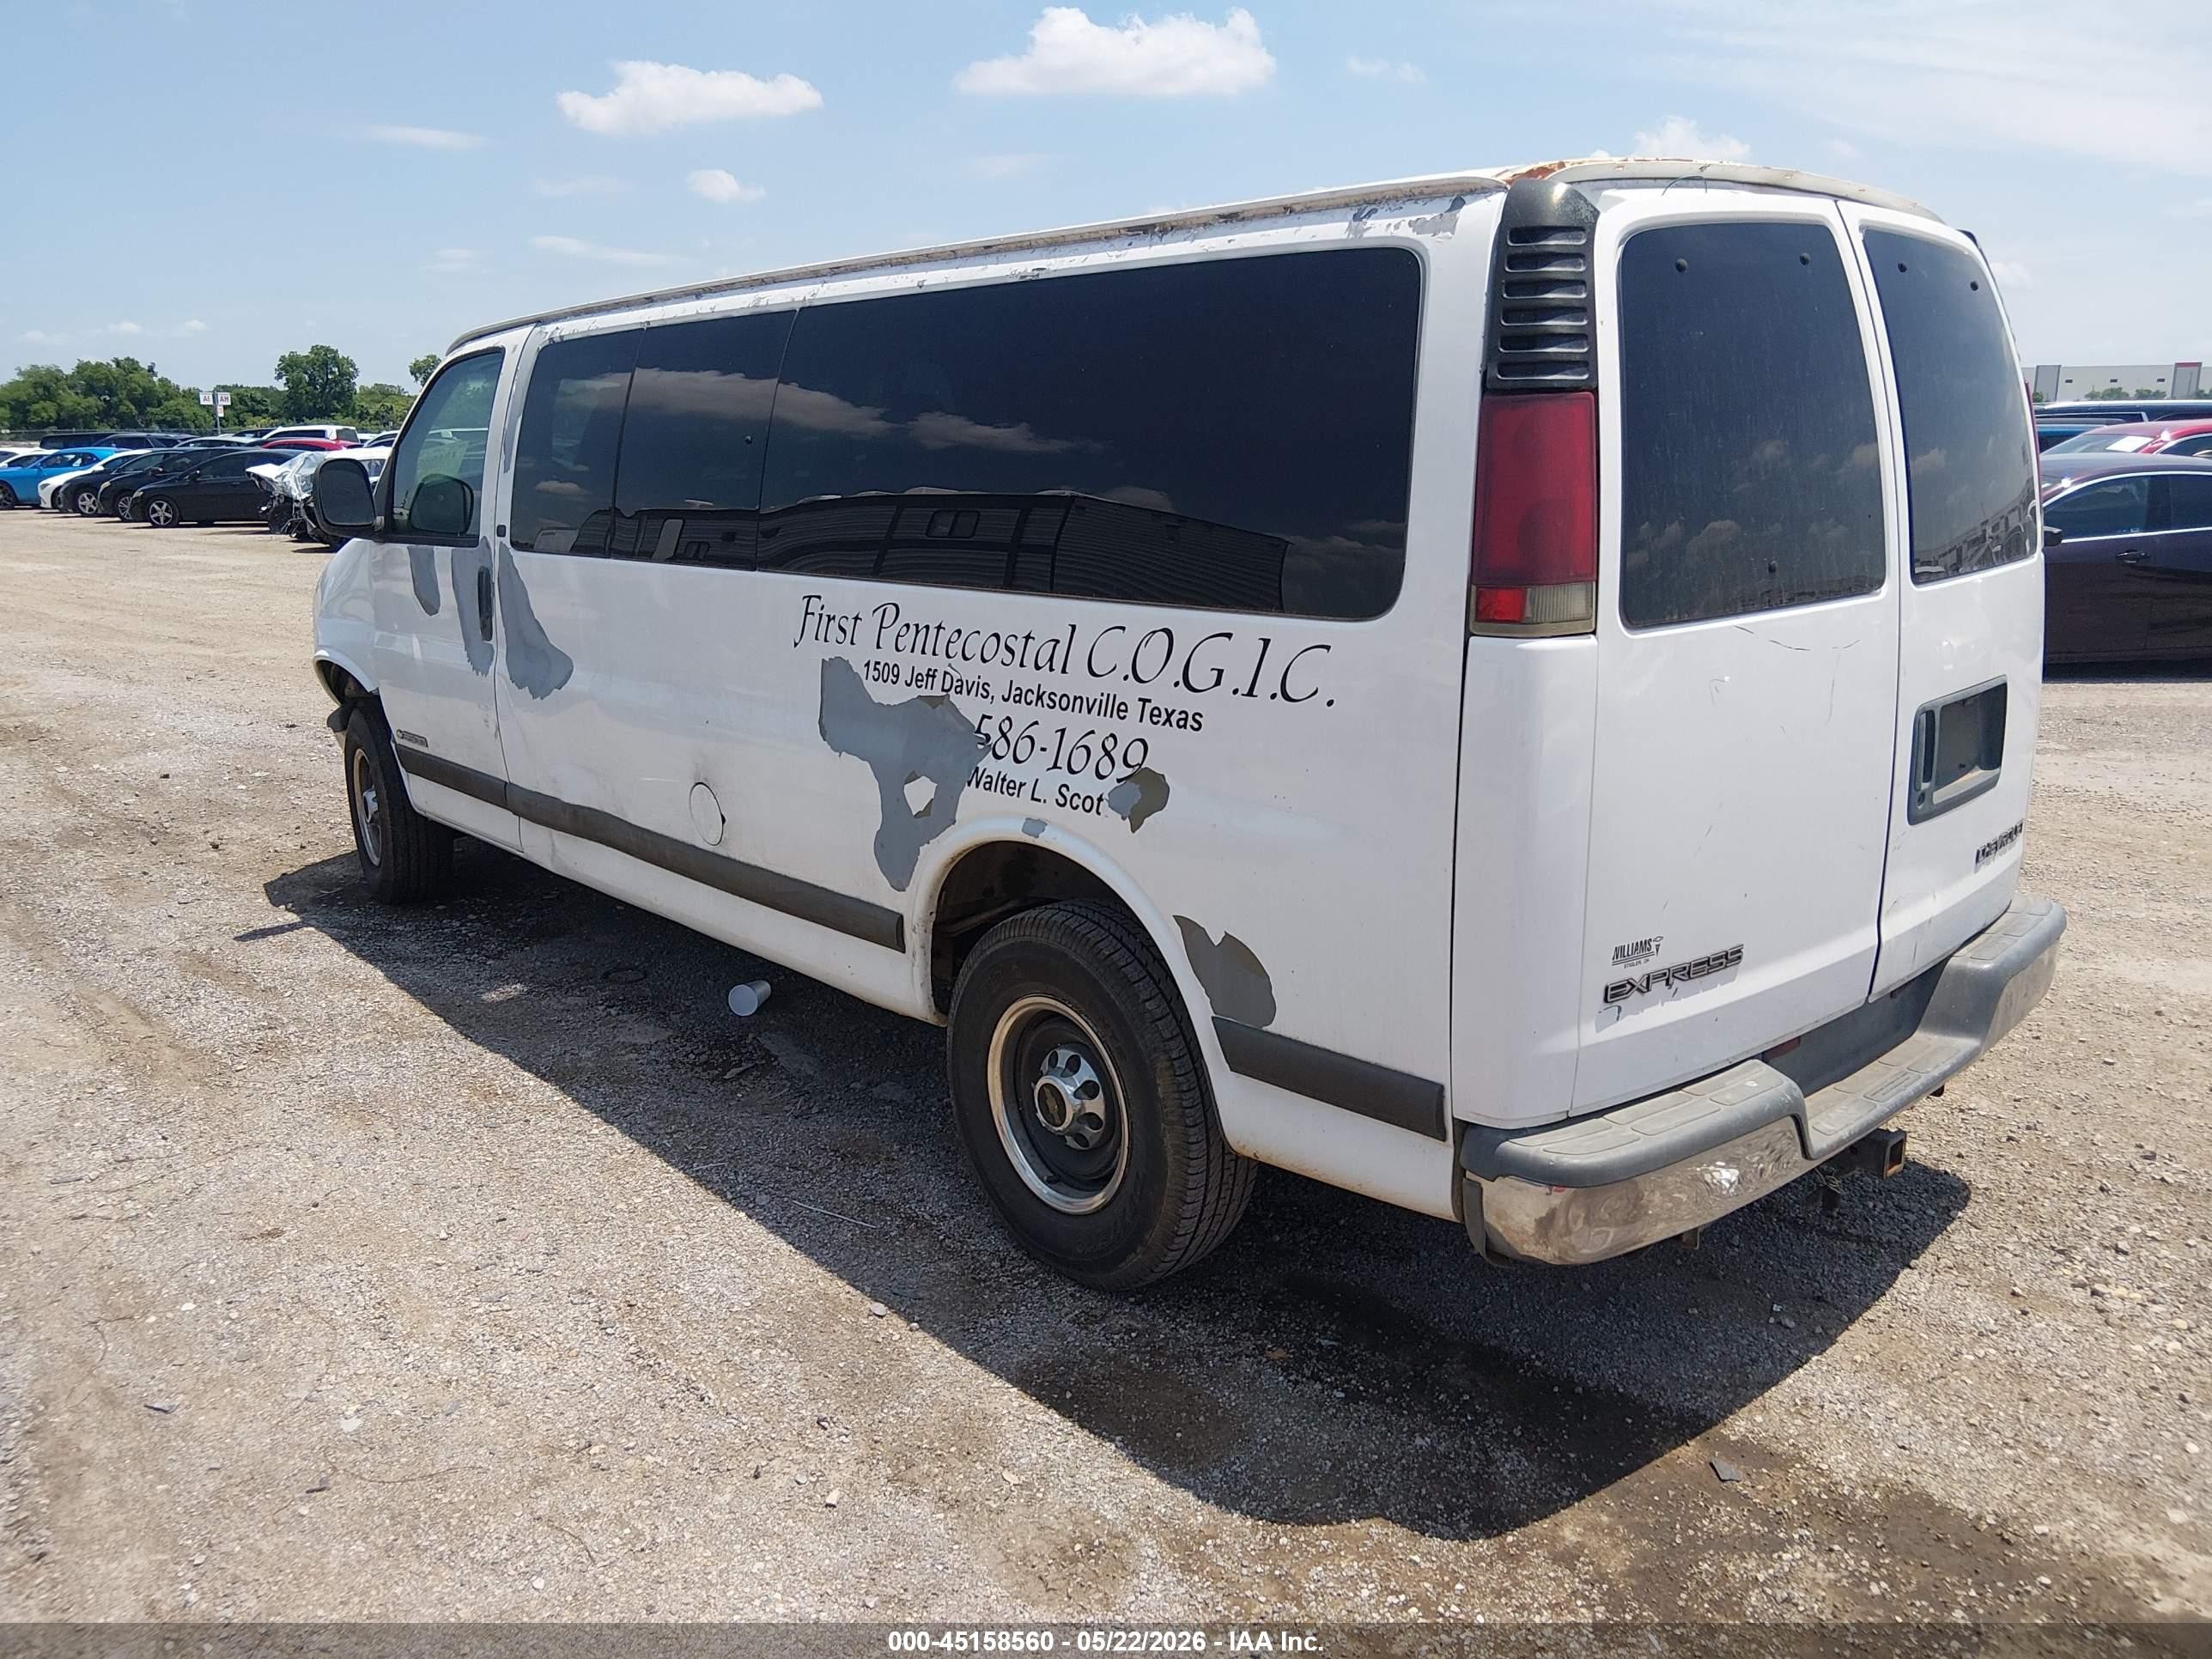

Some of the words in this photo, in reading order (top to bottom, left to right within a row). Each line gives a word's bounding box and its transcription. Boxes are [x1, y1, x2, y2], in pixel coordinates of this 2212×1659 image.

[793, 594, 863, 648] First
[872, 602, 1078, 675] Pentecostal
[1086, 625, 1335, 708] C.O.G.I.C.
[864, 659, 900, 685] 1509
[904, 665, 938, 690] Jeff
[941, 670, 995, 705] Davis,
[1001, 679, 1128, 720] Jacksonville
[1137, 697, 1204, 732] Texas
[973, 713, 1149, 784] 586-1689
[1030, 778, 1047, 804] L.
[1603, 944, 1745, 1004] EXPRESS
